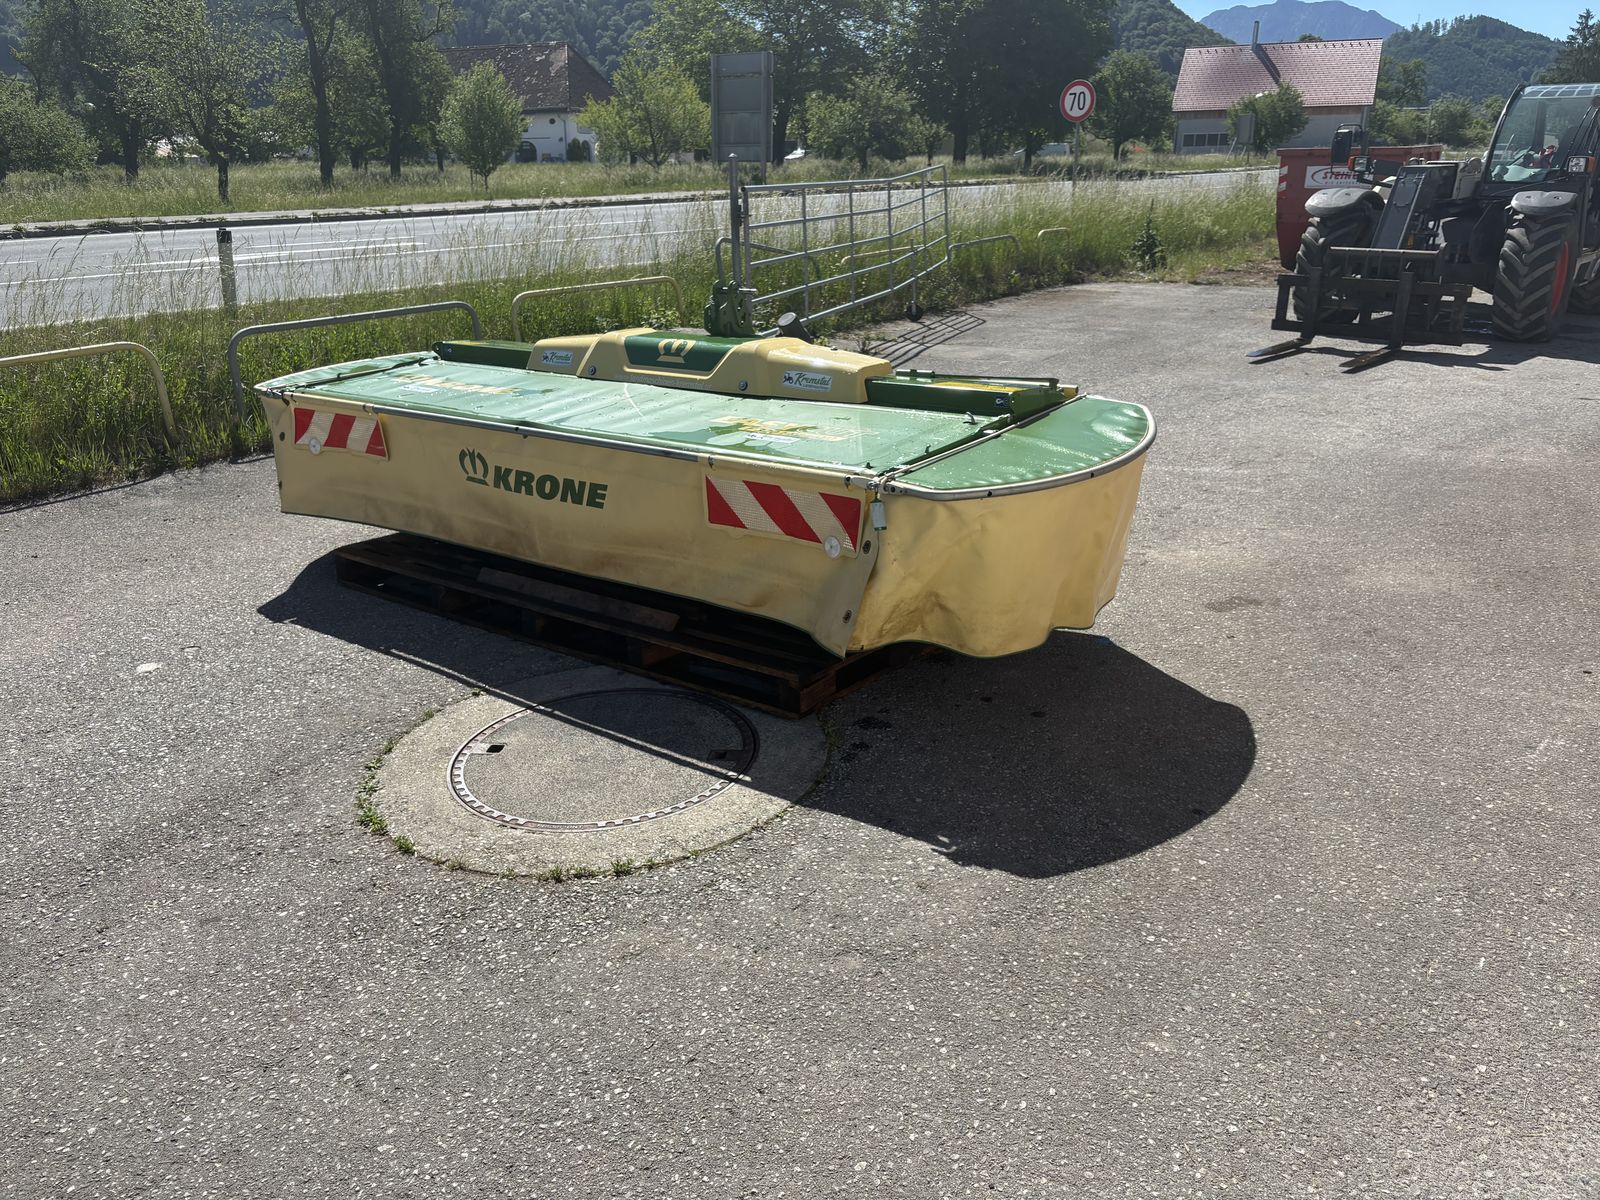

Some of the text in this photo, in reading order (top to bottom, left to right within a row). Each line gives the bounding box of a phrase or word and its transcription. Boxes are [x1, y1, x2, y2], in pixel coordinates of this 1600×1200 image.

[1069, 91, 1086, 111] 70
[794, 372, 832, 386] Kremstal
[493, 465, 608, 509] KRONE
